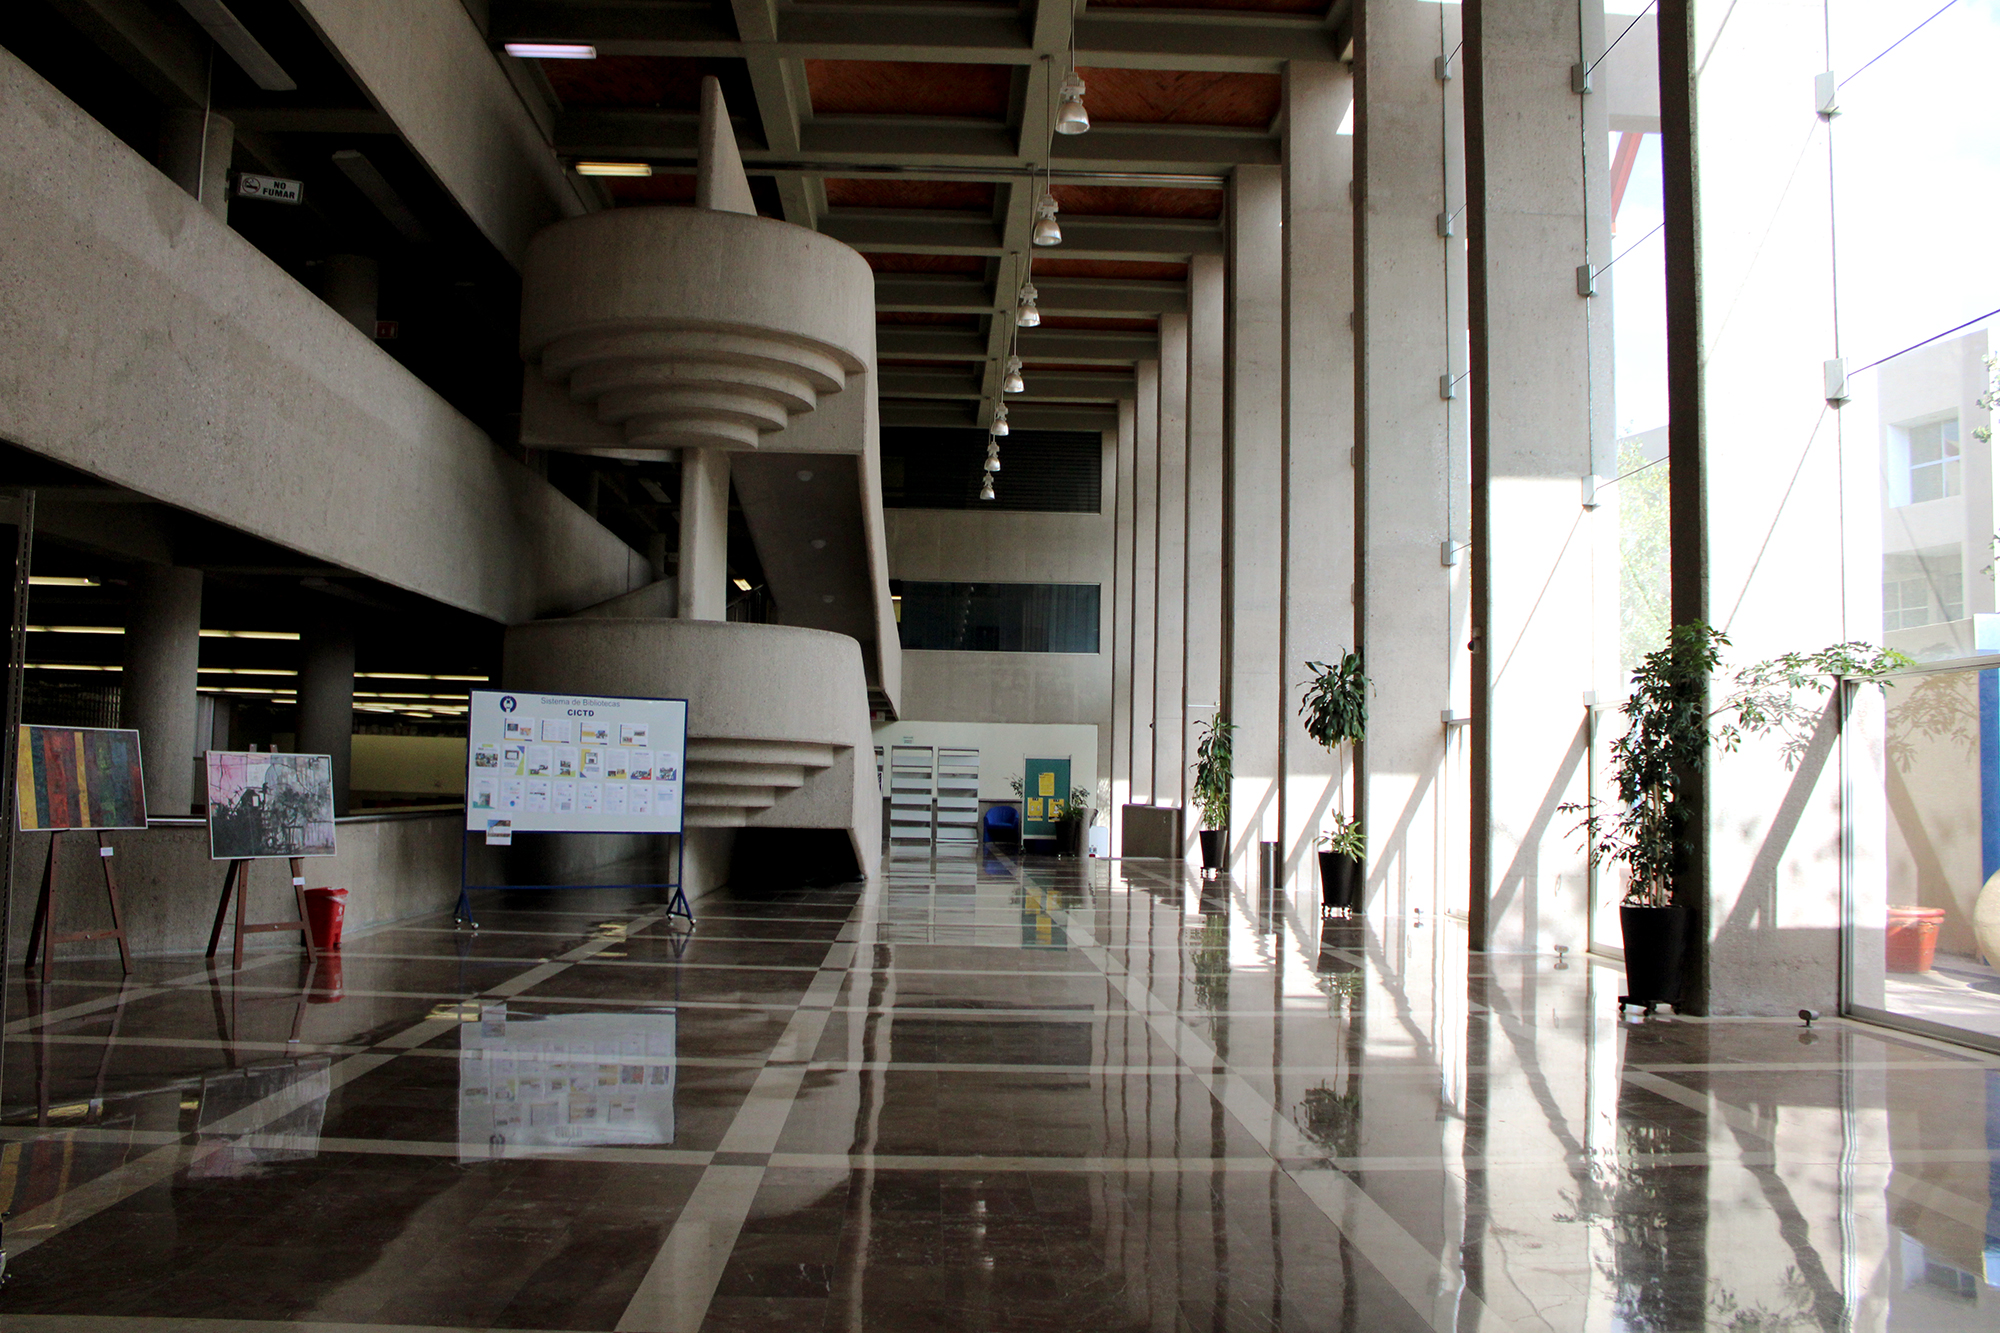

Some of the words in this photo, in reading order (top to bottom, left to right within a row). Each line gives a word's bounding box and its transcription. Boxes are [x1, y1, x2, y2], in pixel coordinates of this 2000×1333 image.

[273, 181, 286, 189] NO
[262, 187, 295, 199] FUMAR
[540, 697, 570, 705] Sistema
[571, 698, 581, 706] de
[582, 698, 621, 707] Bibliotecas
[567, 708, 595, 717] CICTD
